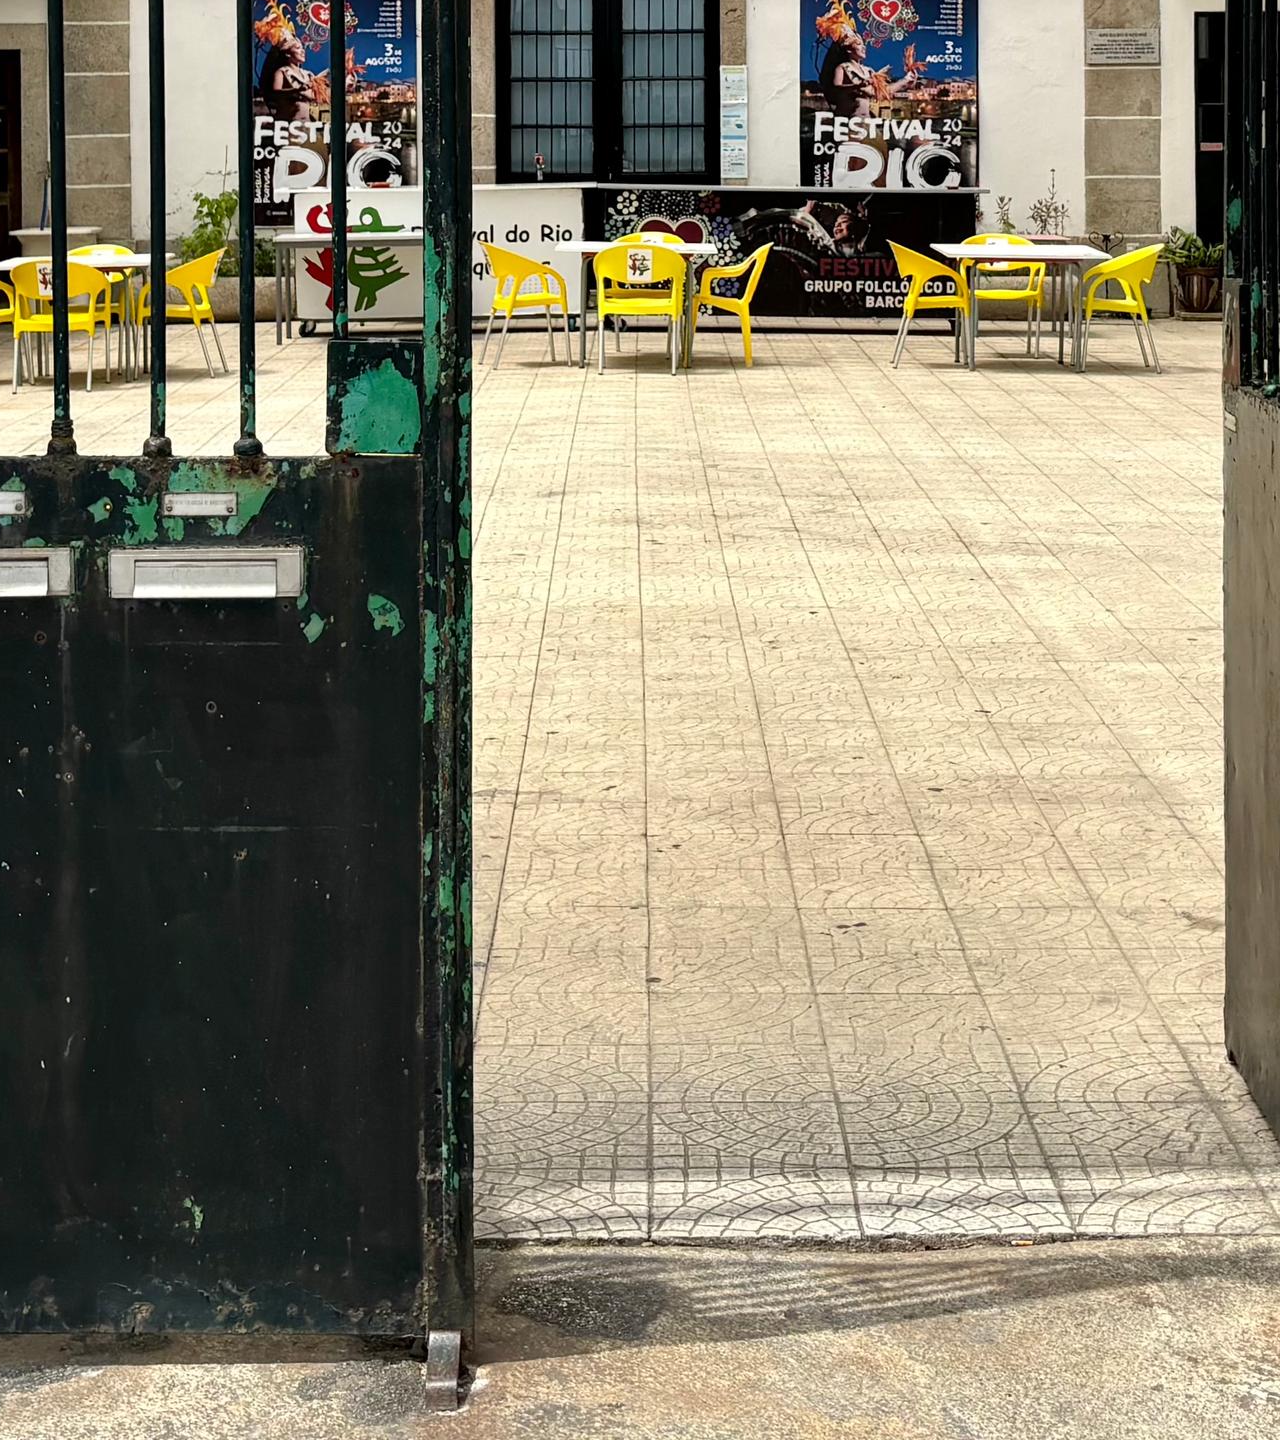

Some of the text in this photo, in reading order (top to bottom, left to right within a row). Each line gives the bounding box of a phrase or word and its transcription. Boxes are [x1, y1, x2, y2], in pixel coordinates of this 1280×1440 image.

[384, 43, 394, 56] 3
[945, 40, 954, 54] 3
[364, 56, 402, 66] AGOSTO
[925, 54, 963, 63] AGOSTO
[254, 116, 402, 147] FESTIAL 20
[813, 110, 963, 143] FESTIVAL 20
[384, 137, 402, 150] 24
[943, 135, 962, 148] 24
[253, 147, 277, 161] DO
[813, 143, 837, 156] DO
[505, 224, 530, 243] do
[541, 224, 573, 243] Rio
[804, 280, 853, 294] GRUPO
